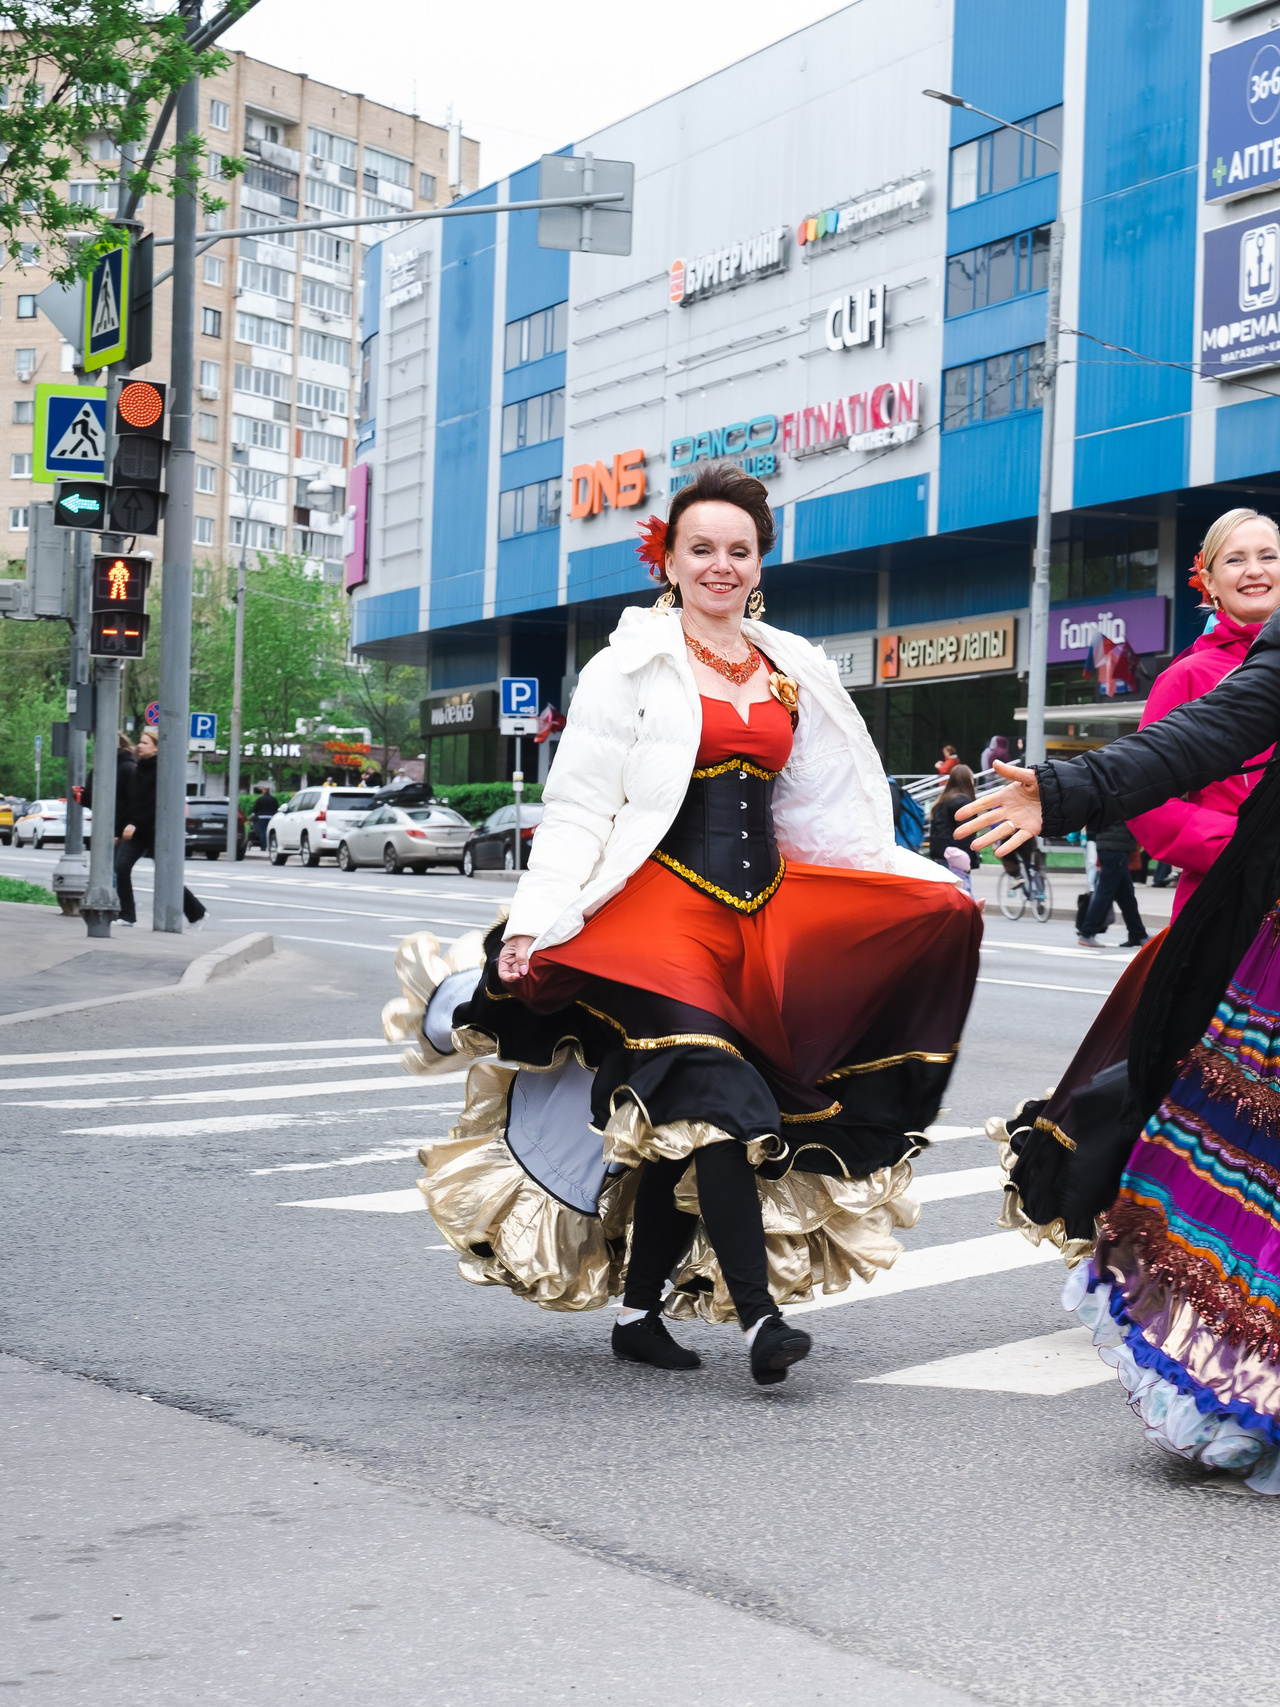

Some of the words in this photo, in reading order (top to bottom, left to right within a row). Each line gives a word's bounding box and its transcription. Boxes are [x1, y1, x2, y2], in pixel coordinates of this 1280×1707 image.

[685, 243, 741, 294] БУРГЕР
[740, 228, 784, 275] КИНГ
[670, 413, 778, 468] DANCO
[782, 379, 920, 453] FITNATION
[570, 448, 646, 520] DNS
[197, 716, 211, 736] P
[511, 682, 531, 711] P
